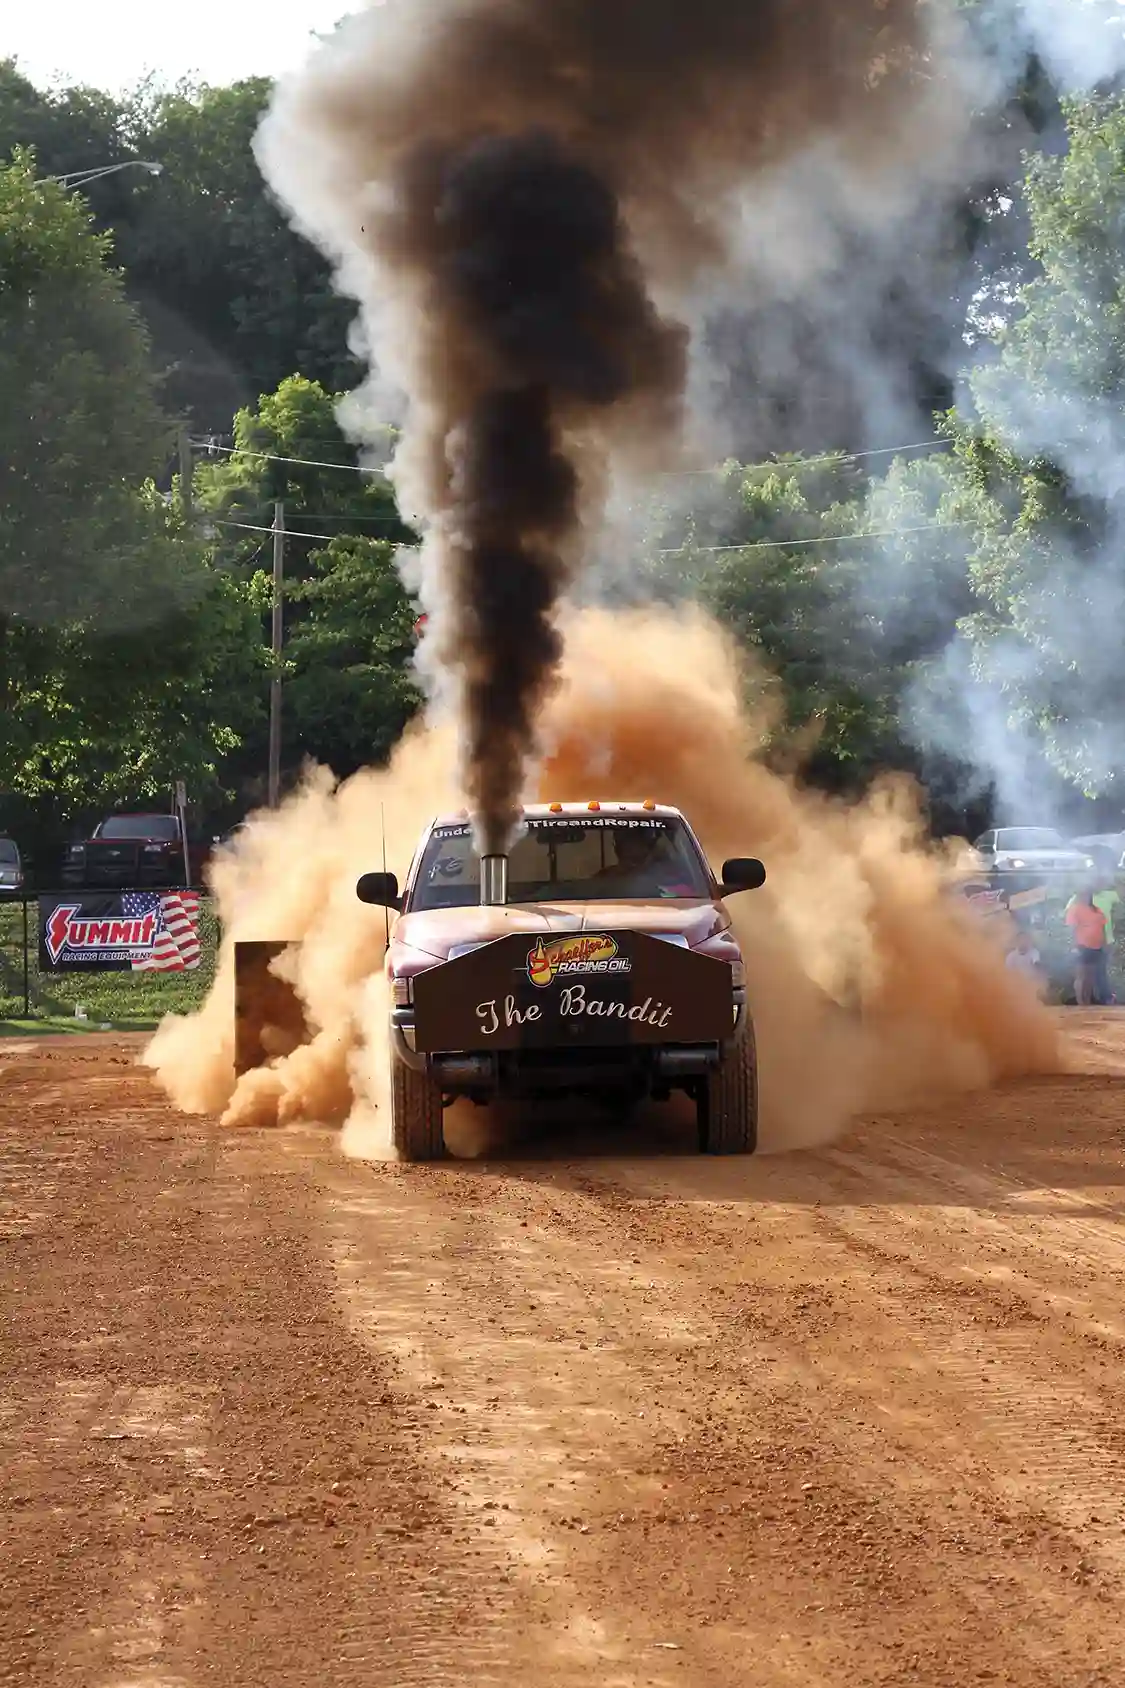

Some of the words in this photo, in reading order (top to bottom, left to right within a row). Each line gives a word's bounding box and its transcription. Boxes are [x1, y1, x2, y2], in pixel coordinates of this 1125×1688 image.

[434, 827, 473, 839] Unde
[62, 951, 97, 961] RACING
[98, 951, 153, 961] EQUIPMENT
[558, 960, 608, 972] RACING
[608, 958, 631, 971] OIL
[475, 994, 542, 1035] The
[560, 984, 673, 1028] Bandit
